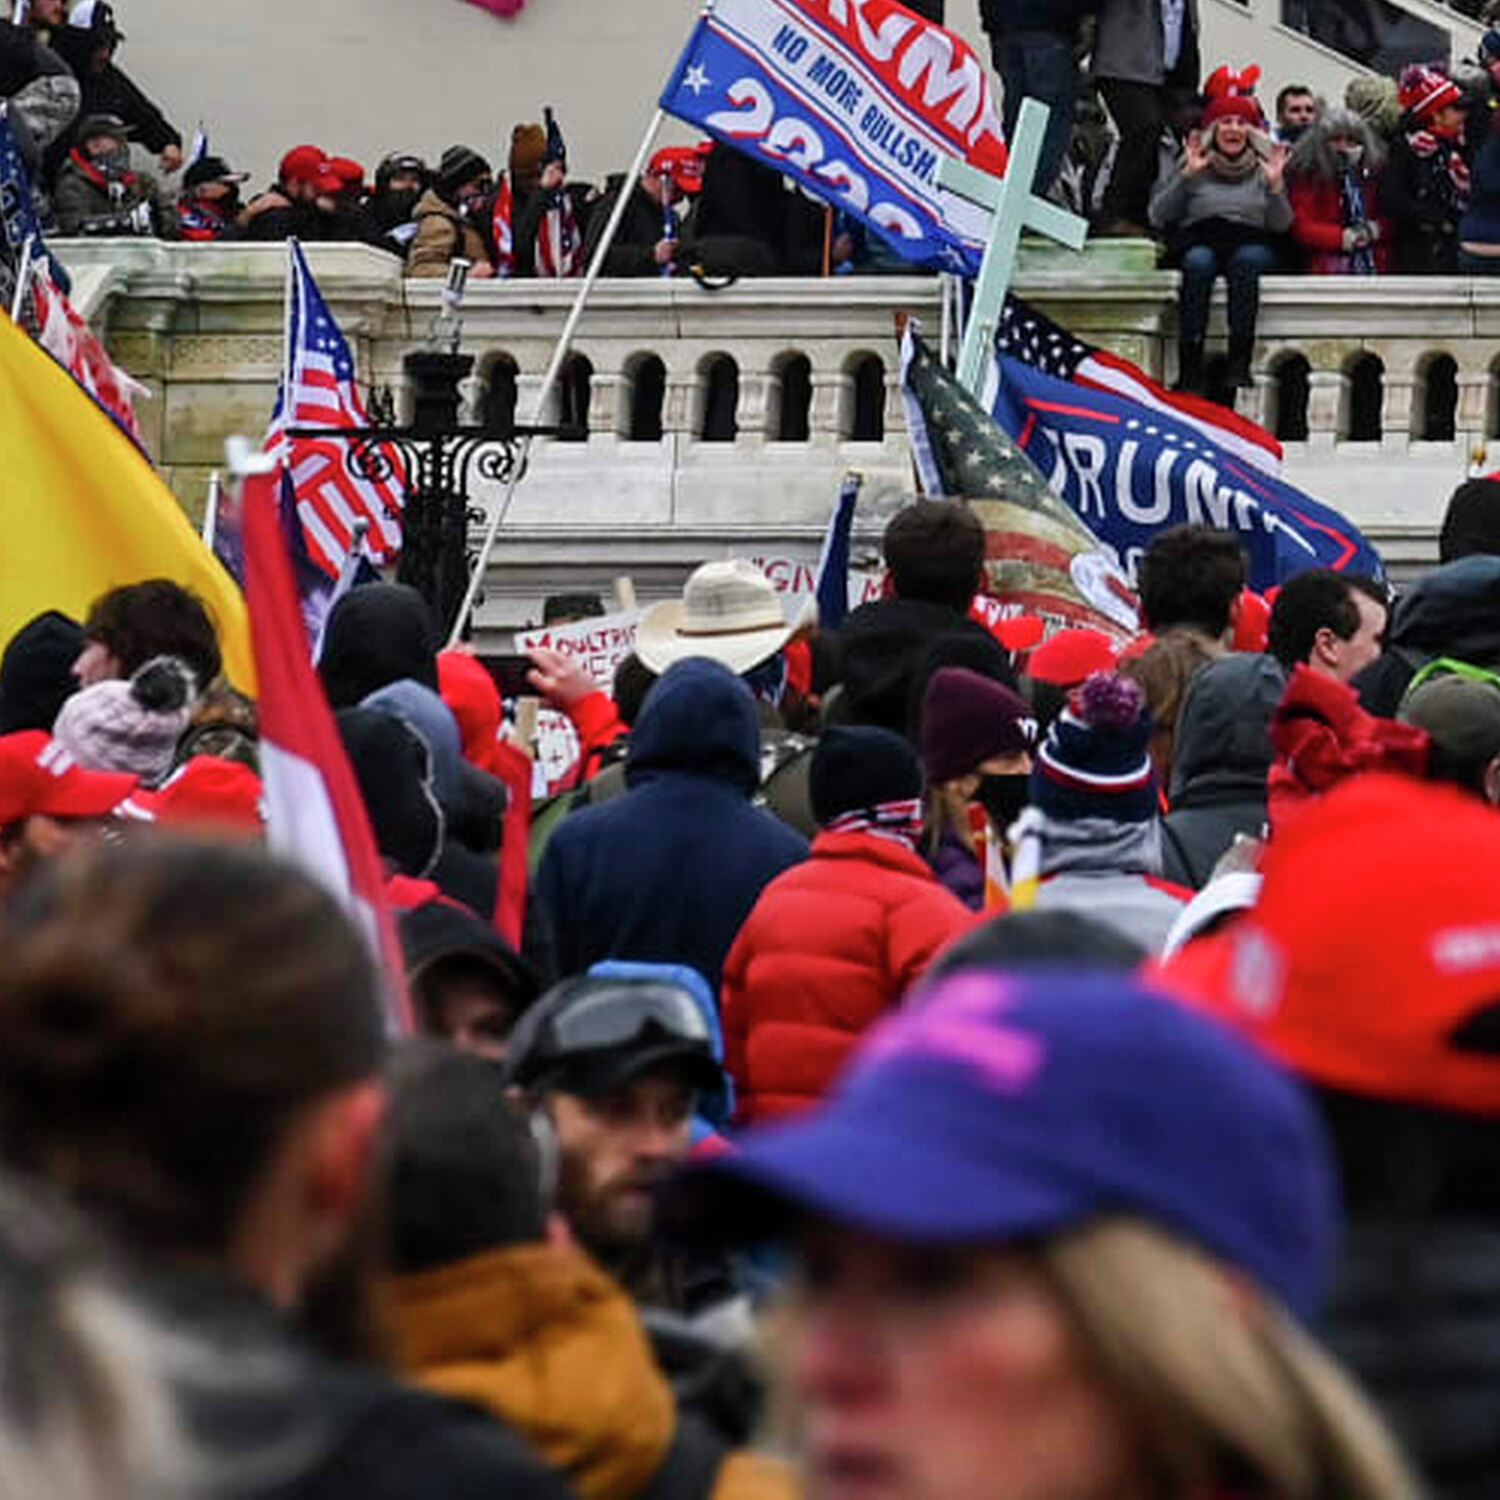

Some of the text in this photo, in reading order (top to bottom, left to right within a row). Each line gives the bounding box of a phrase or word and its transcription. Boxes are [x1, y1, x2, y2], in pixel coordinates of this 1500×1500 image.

[770, 23, 943, 192] NO MORE BULLSH
